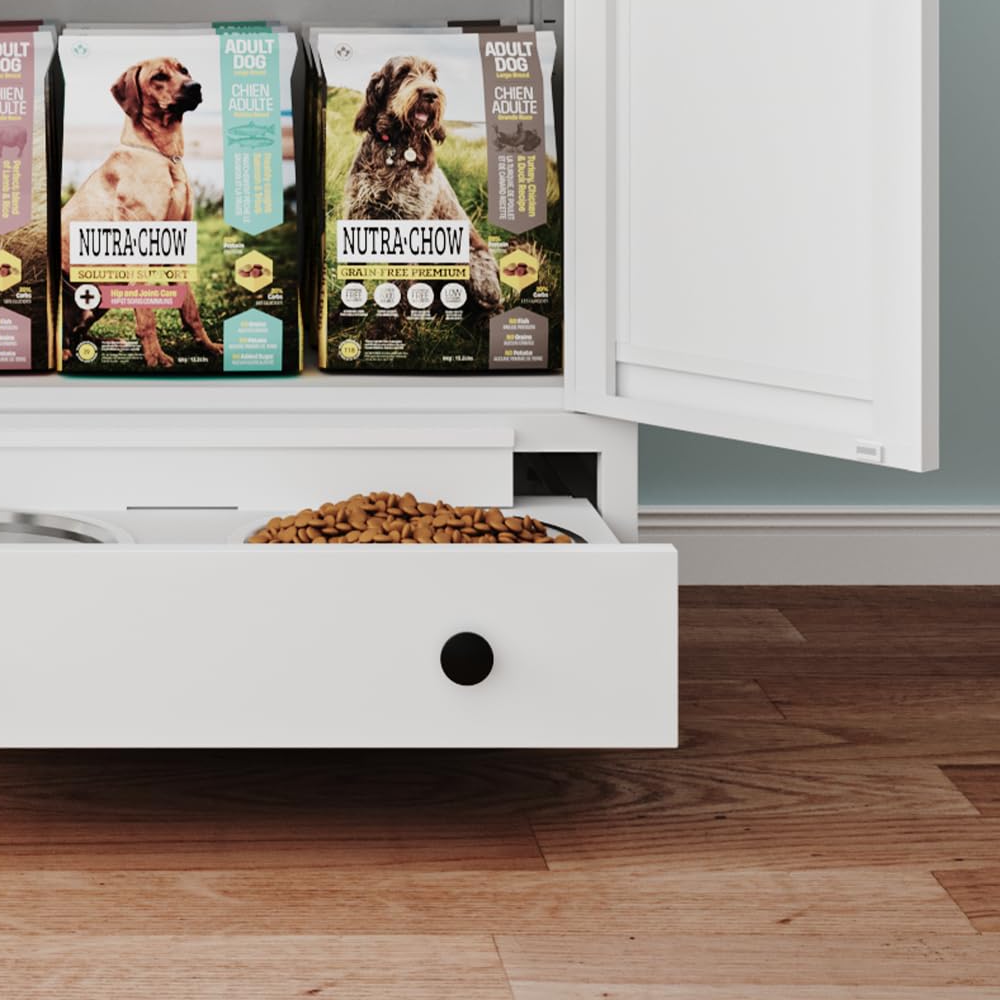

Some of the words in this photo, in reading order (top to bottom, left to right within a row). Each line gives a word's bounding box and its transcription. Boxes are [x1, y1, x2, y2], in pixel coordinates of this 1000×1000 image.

[225, 40, 275, 54] ADULT
[485, 41, 533, 57] ADULT
[233, 55, 266, 69] DOG
[495, 57, 528, 72] DOG
[232, 84, 270, 97] CHIEN
[494, 86, 533, 100] CHIEN
[228, 97, 274, 111] ADULTE
[492, 100, 538, 114] ADULTE
[78, 269, 134, 280] SOLUTION
[411, 268, 467, 278] PREMIUM
